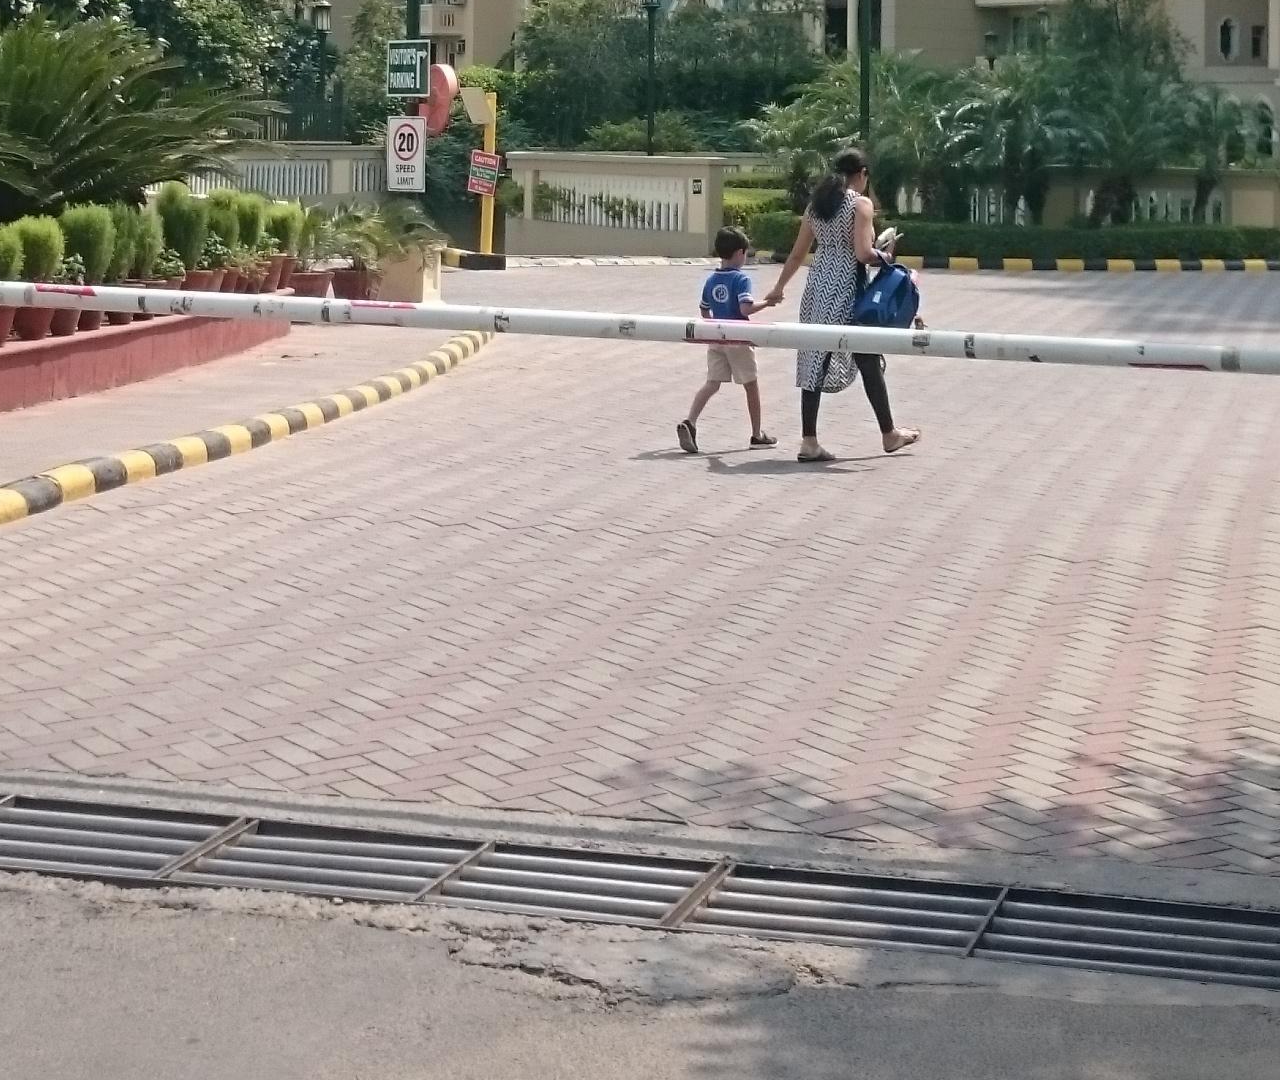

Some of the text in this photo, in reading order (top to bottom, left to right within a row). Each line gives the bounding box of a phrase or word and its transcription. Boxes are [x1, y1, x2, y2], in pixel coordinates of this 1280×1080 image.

[389, 48, 417, 65] VISITOR'S
[389, 71, 415, 88] PARKING
[398, 132, 415, 152] 20
[474, 154, 497, 166] CAUTION
[395, 164, 416, 173] SPEED
[397, 177, 414, 185] LIMIT
